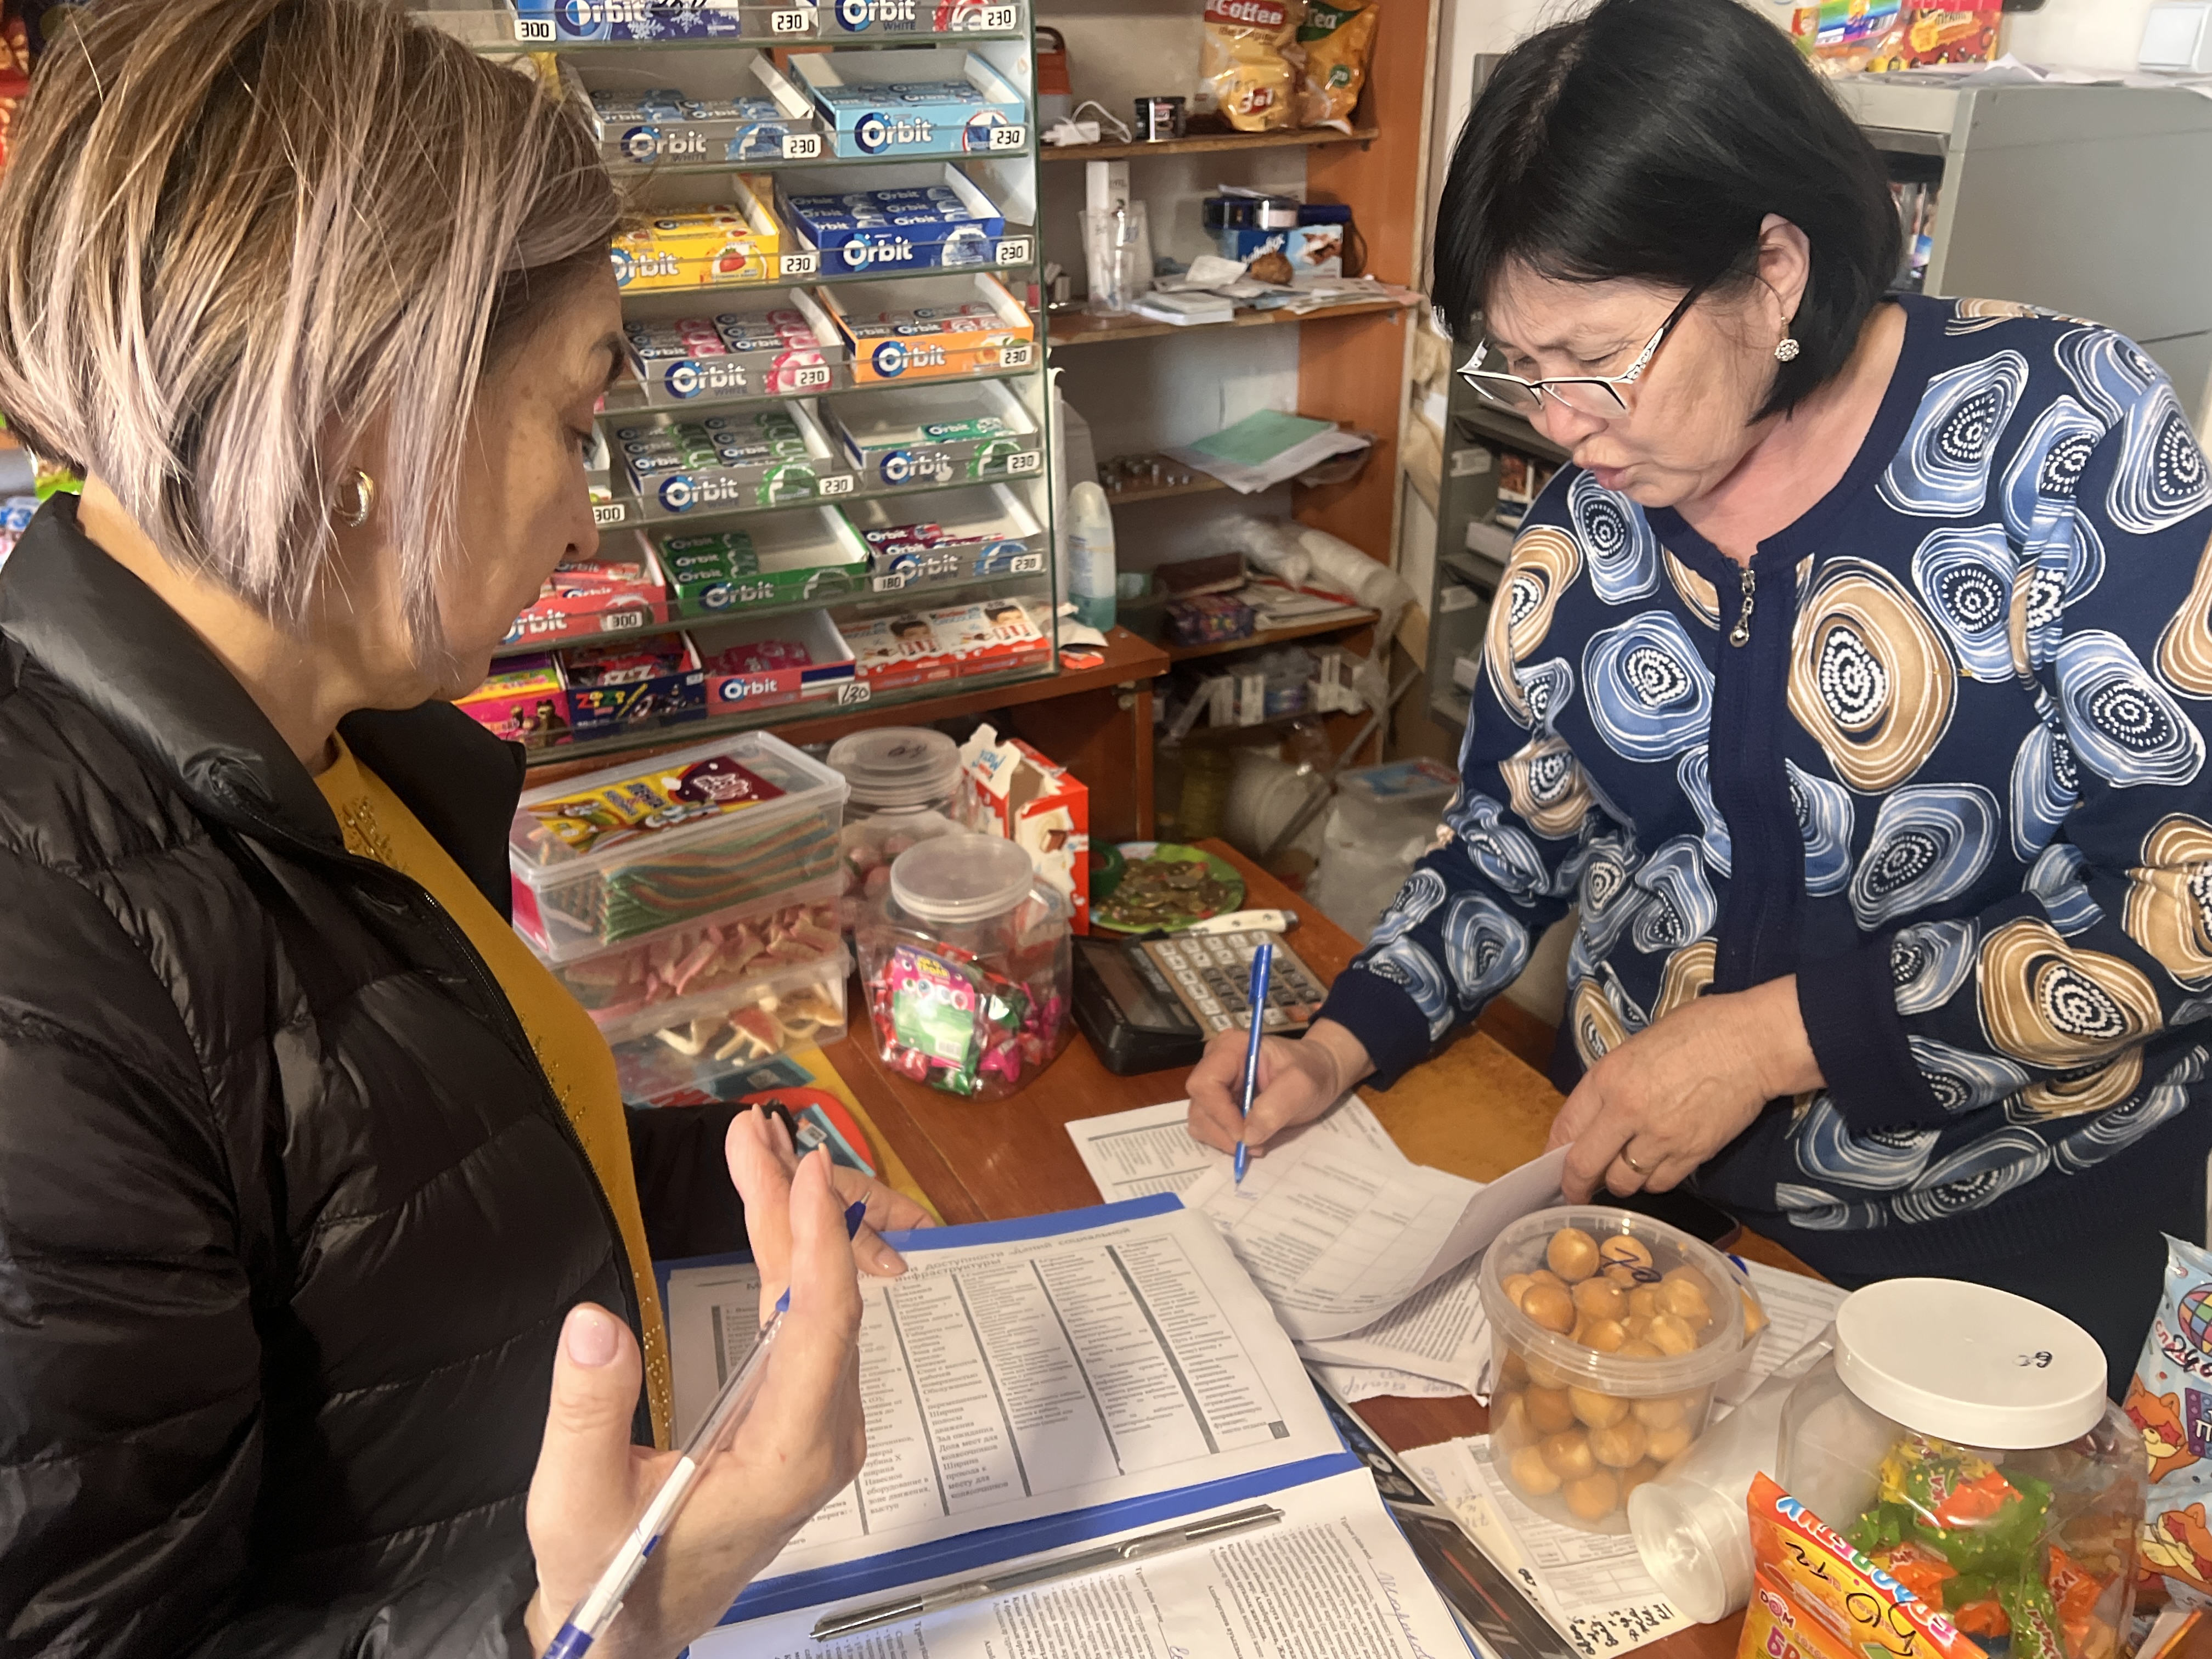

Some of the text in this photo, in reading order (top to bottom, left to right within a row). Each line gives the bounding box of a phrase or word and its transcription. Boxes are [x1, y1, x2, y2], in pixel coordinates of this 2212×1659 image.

[777, 15, 802, 30] 230
[883, 21, 916, 31] WHITE
[988, 10, 1012, 26] 230
[521, 22, 549, 38] 300
[857, 115, 932, 149] Orbit
[996, 129, 1019, 145] 230
[624, 128, 707, 159] Orbit
[790, 138, 815, 154] 230
[843, 235, 913, 266] Orbit
[1001, 251, 1024, 261] 230
[787, 257, 810, 272] 230
[878, 345, 945, 373] Orbit
[1005, 349, 1027, 364] 230
[669, 363, 747, 393] Orbit
[800, 371, 824, 384] 230
[1012, 455, 1035, 468] 230
[665, 476, 739, 507] Orbit
[824, 479, 848, 492] 230
[1015, 558, 1036, 571] 230
[706, 582, 774, 608] Orbit
[723, 678, 778, 701] Orbit
[926, 1251, 1004, 1269] доступности
[1058, 1227, 1131, 1245] социальной
[895, 1258, 1002, 1282] инфраструктуры
